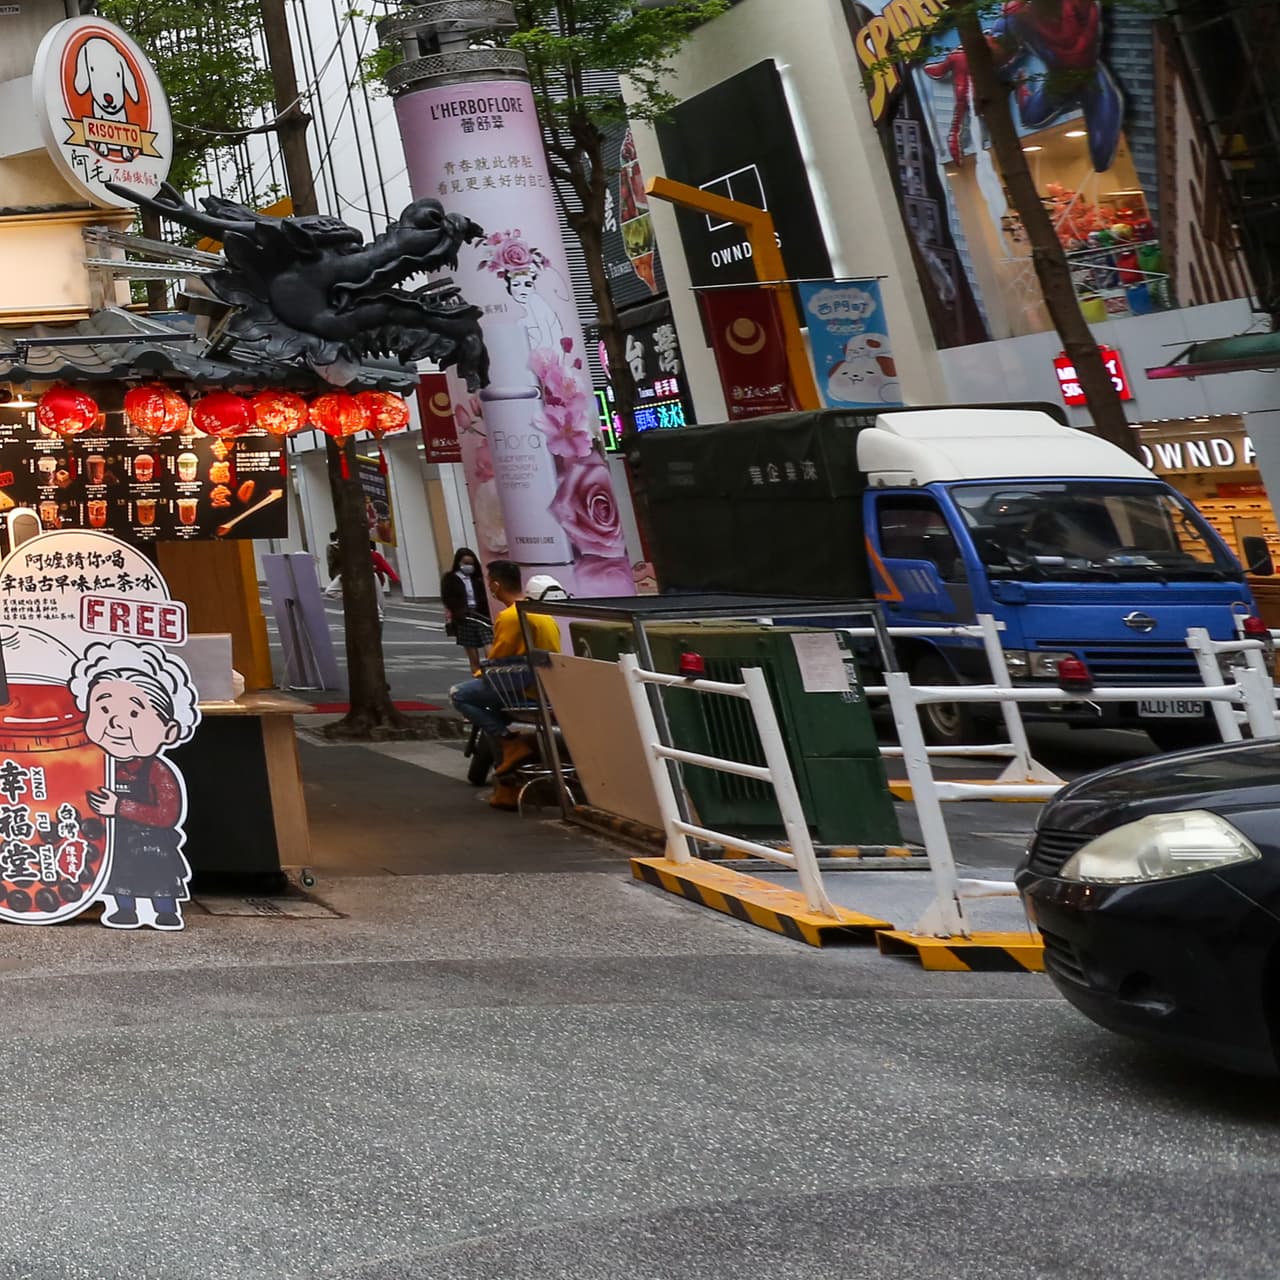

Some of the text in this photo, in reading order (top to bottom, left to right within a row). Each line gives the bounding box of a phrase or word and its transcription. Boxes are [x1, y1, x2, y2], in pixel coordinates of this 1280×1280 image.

[430, 97, 524, 120] L'HERBOFLORE
[88, 122, 138, 142] RISOTTO
[71, 149, 112, 184] 阿毛
[444, 155, 533, 175] 青春就此停駐
[711, 232, 782, 268] OWNDS
[818, 301, 868, 315] 西門町
[493, 431, 541, 450] Flora
[25, 549, 126, 570] 阿嬤請你喝
[1, 572, 158, 596] 幸福古早味紅茶冰
[86, 599, 177, 640] FREE
[32, 769, 55, 880] XING FU TANG
[59, 805, 78, 838] 台灣
